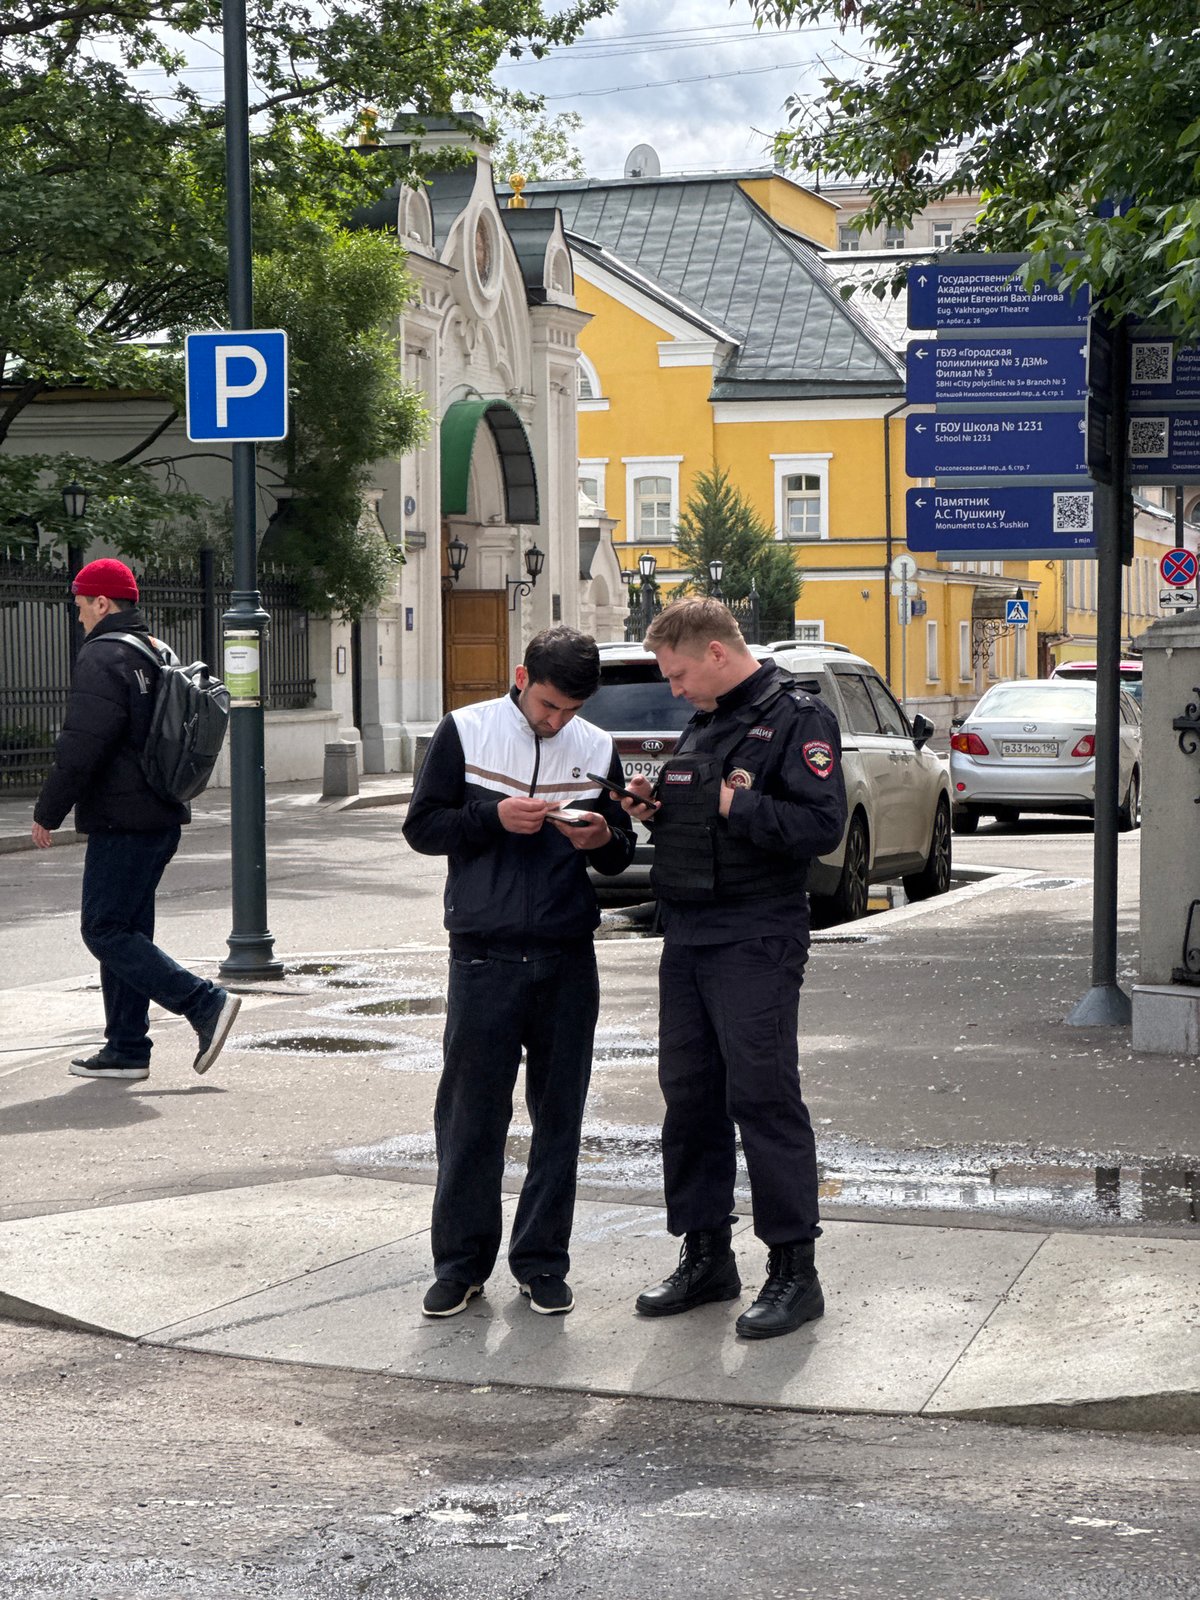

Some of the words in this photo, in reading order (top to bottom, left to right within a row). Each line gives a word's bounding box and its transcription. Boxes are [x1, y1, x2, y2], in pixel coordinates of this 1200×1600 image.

[1014, 284, 1040, 294] тер
[938, 296, 970, 304] имени
[971, 294, 1008, 304] Евгения
[1010, 294, 1064, 302] Вахтангова
[937, 306, 953, 315] Eug.
[954, 306, 998, 315] Vakhtangov
[936, 348, 957, 358] ГБУЗ
[958, 348, 1012, 358] «Городская
[936, 359, 999, 368] поликлиника
[1002, 358, 1012, 367] №
[1015, 358, 1020, 366] 3
[1022, 357, 1048, 367] ДЗМ»
[936, 368, 972, 378] Филиал
[974, 369, 986, 377] №
[987, 368, 993, 377] 3
[215, 346, 268, 428] P
[972, 380, 1006, 388] polyclinic
[935, 422, 961, 432] ГБОУ
[962, 422, 999, 432] Школа
[1002, 421, 1014, 431] №
[1018, 421, 1043, 431] 1231
[935, 497, 990, 506] Памятник
[935, 509, 953, 519] А.С.
[955, 509, 1006, 520] Пушкину
